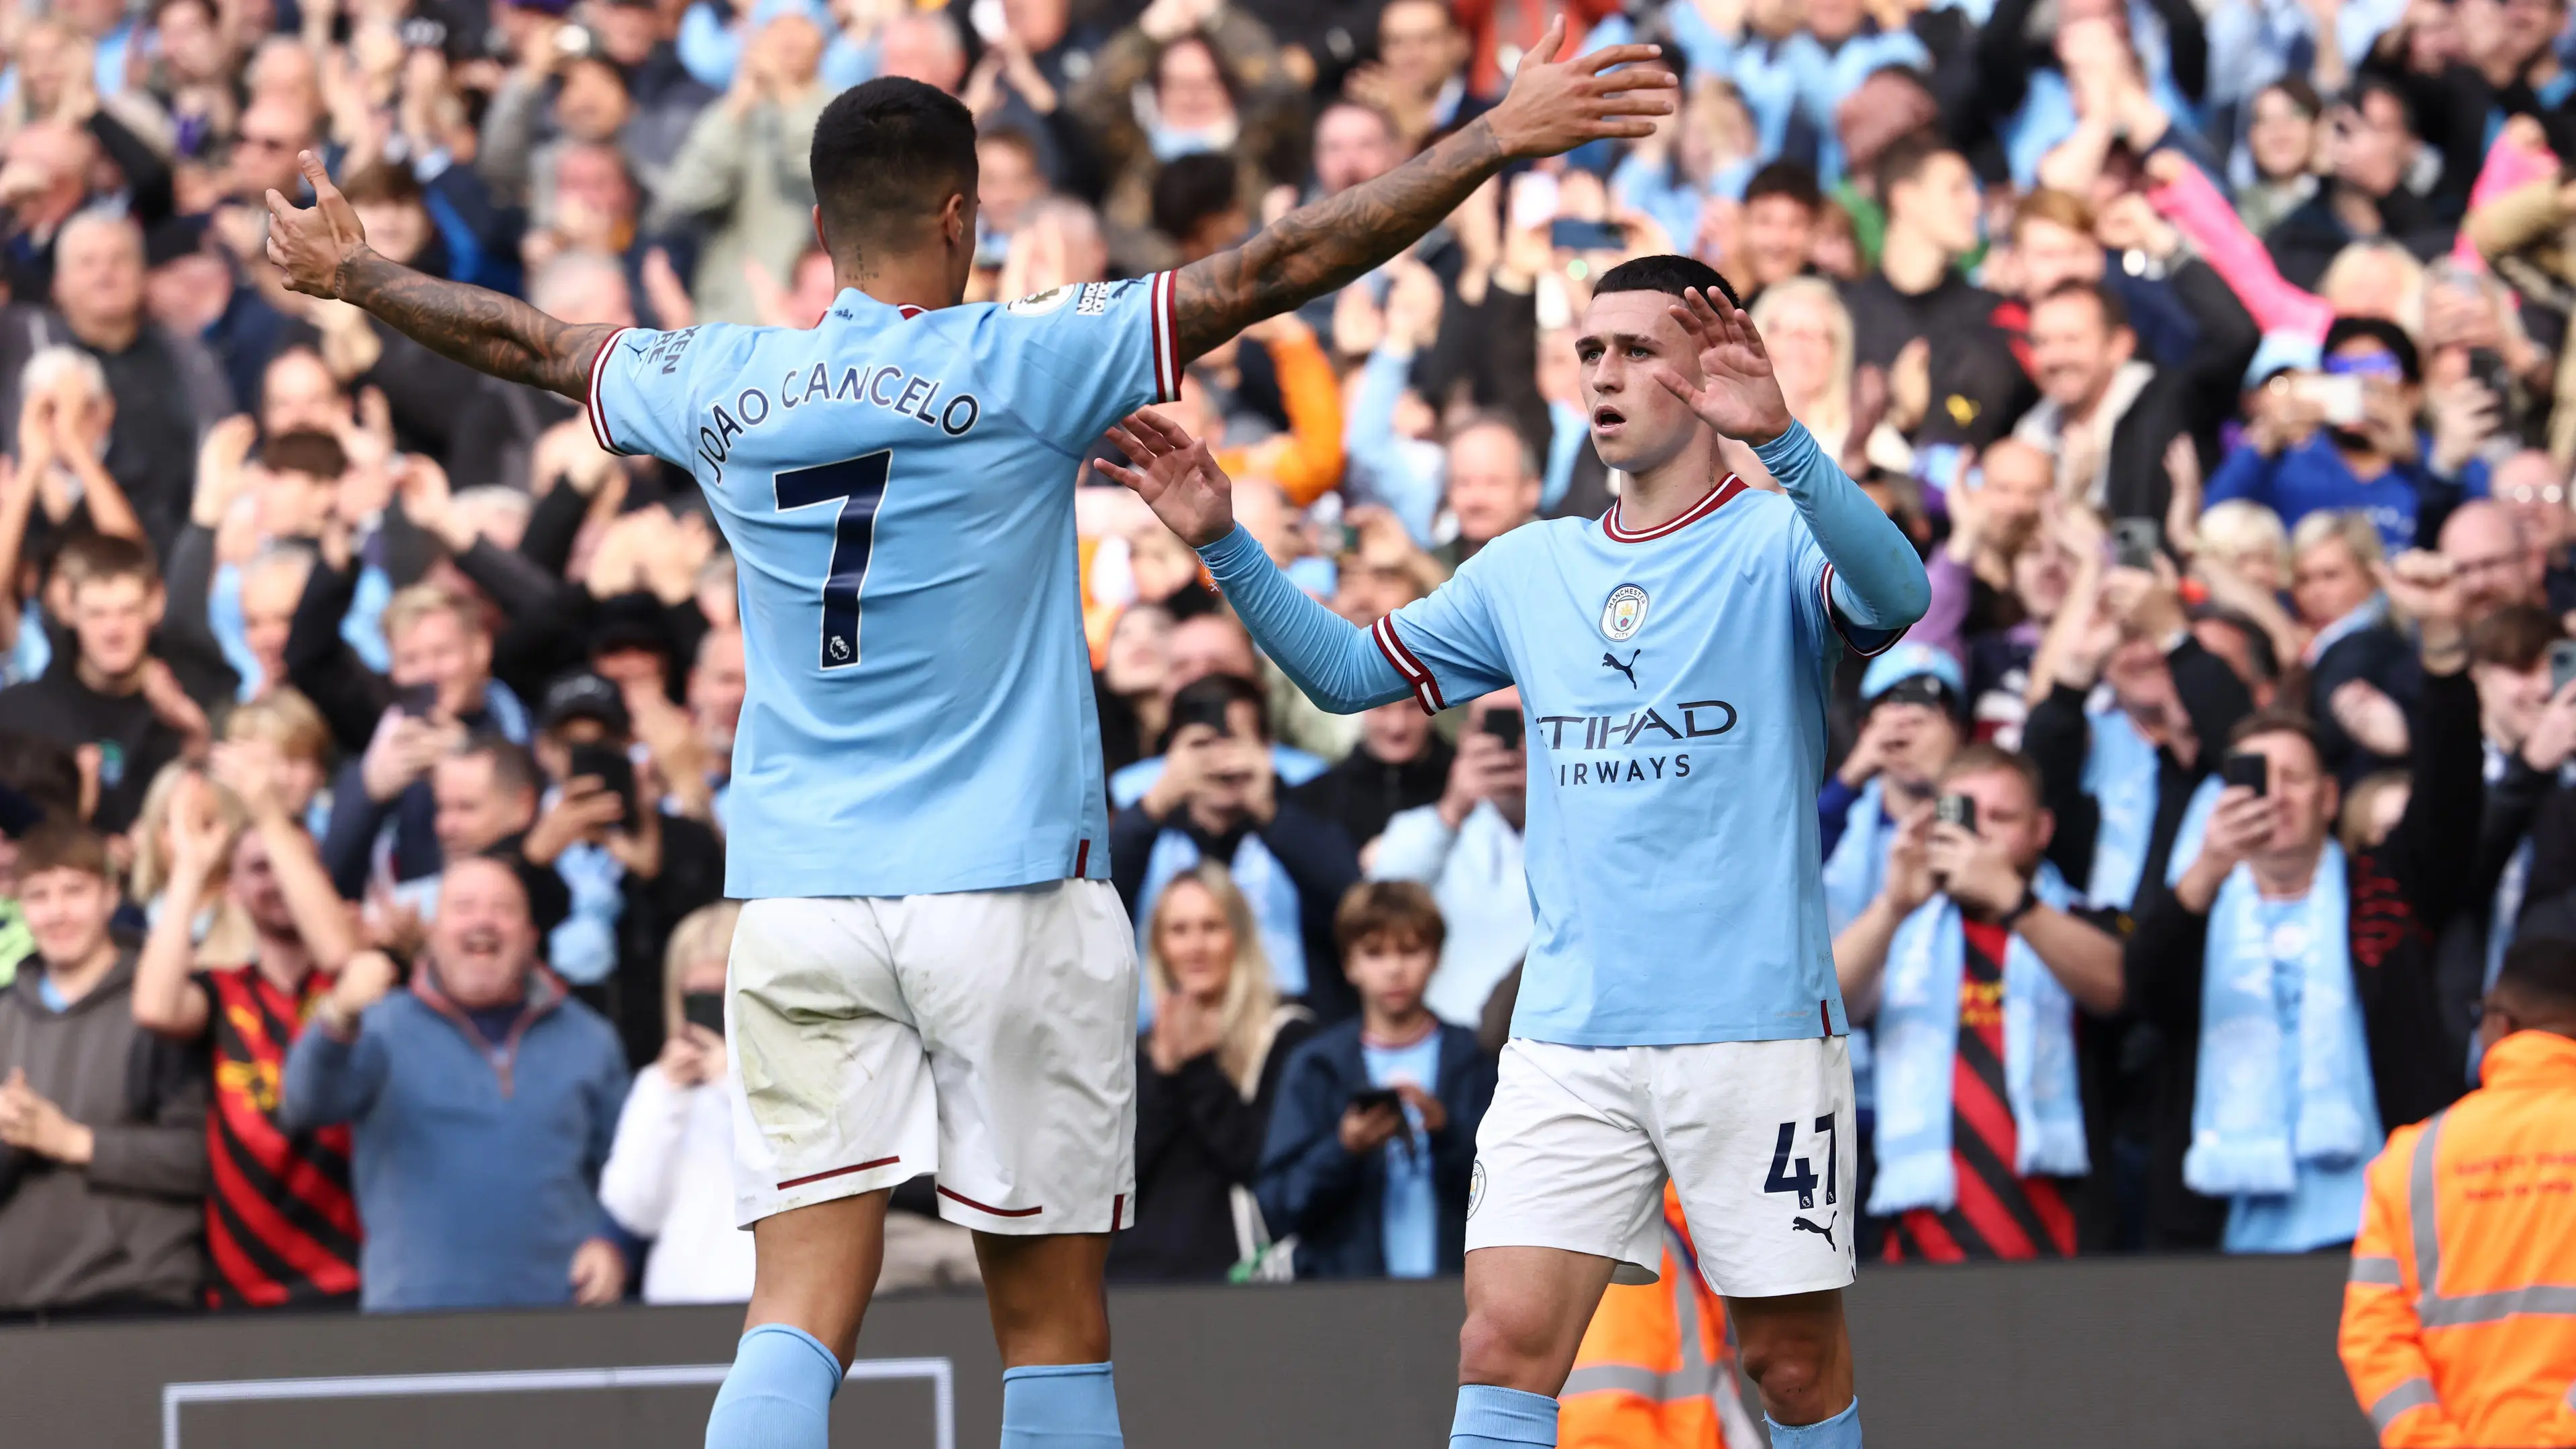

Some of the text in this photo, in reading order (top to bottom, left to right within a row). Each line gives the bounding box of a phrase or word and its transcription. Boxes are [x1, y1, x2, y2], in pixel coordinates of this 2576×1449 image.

[780, 361, 980, 437] CANCELO
[773, 448, 893, 669] 7
[1609, 588, 1646, 609] MANCHESTER
[1536, 700, 1737, 749] TIHAD
[1554, 754, 1690, 786] IRWAYS
